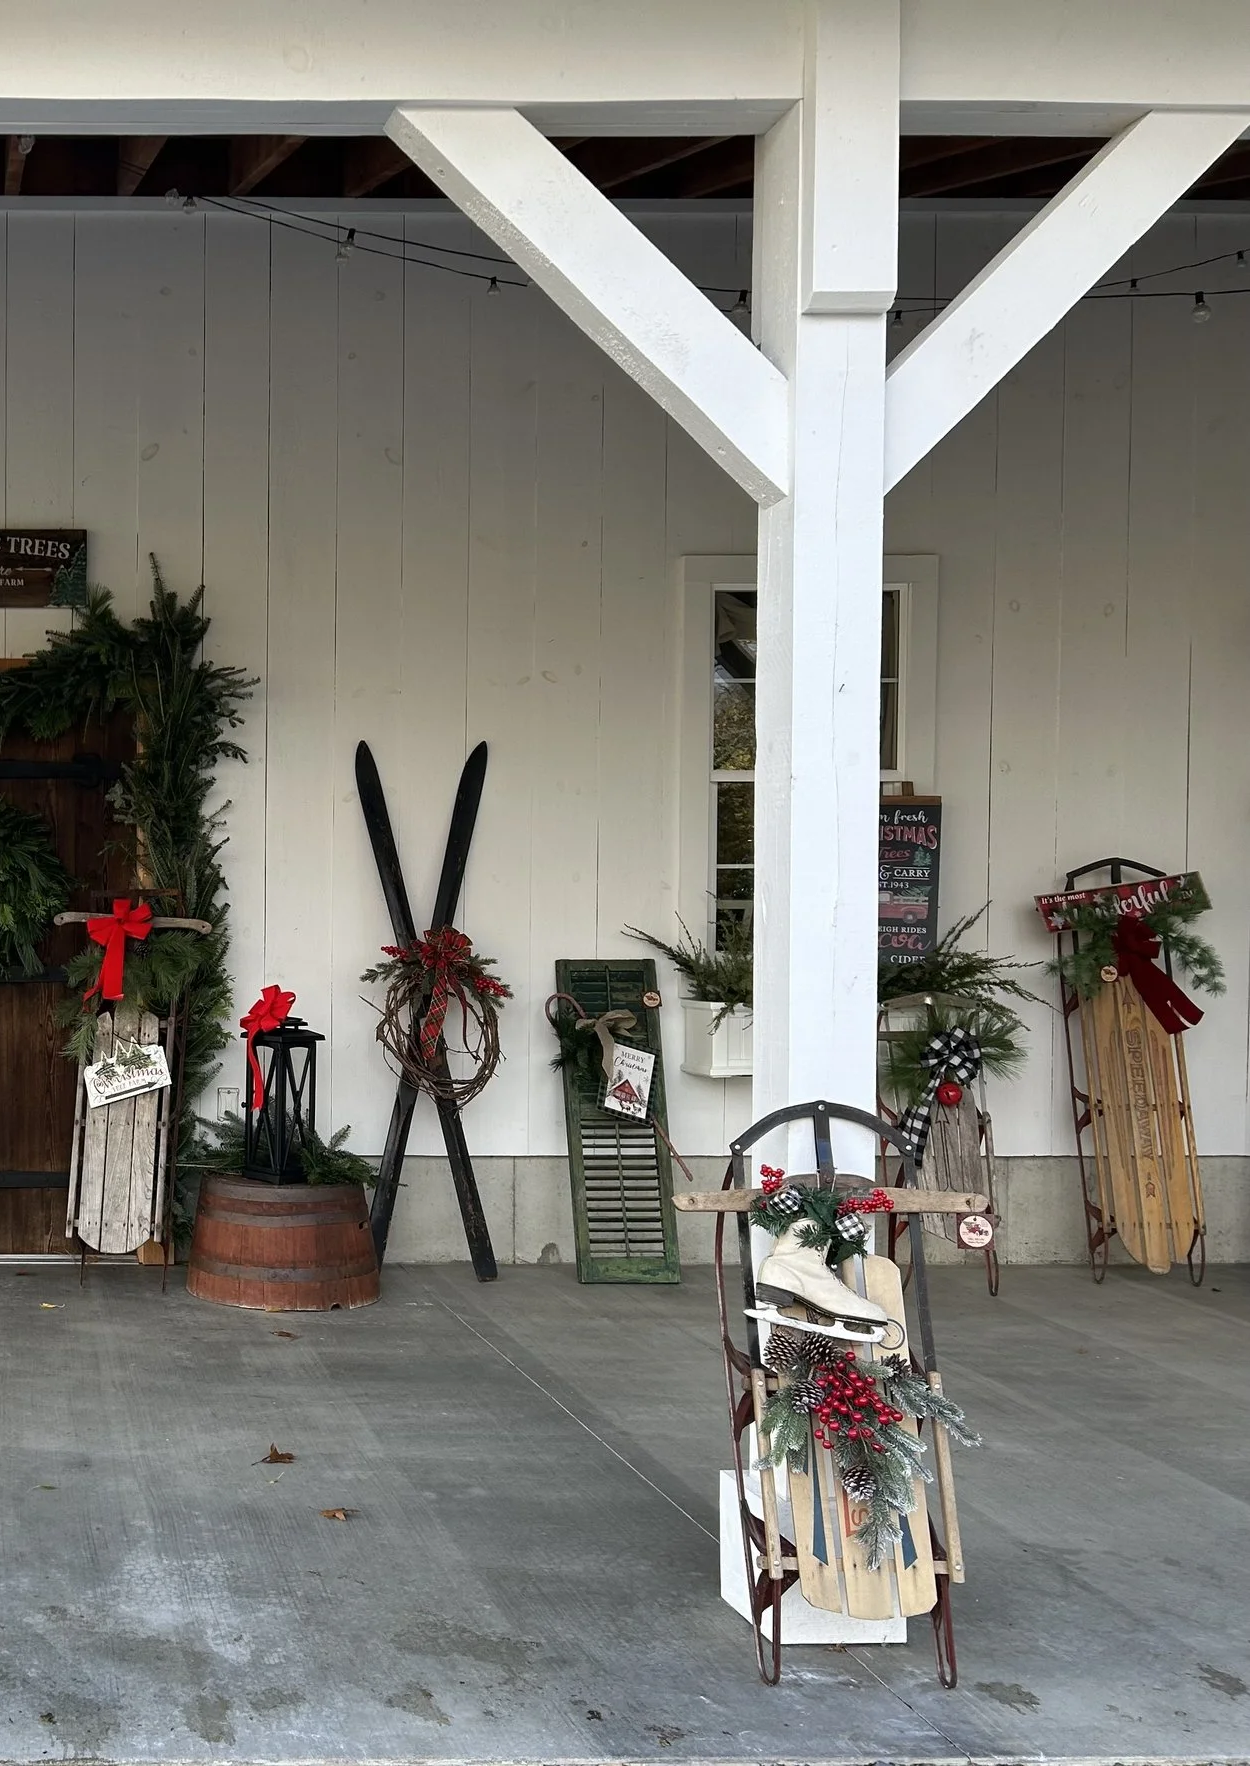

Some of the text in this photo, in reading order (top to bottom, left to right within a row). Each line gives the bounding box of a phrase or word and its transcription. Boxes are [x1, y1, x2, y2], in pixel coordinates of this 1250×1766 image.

[7, 536, 71, 559] TREES
[0, 578, 24, 587] FARM
[894, 809, 929, 825] fresh
[894, 868, 931, 878] CARRY
[1041, 892, 1086, 905] It's the most
[901, 926, 927, 934] RIDES
[622, 1051, 646, 1064] MERRY
[1126, 1029, 1154, 1161] SPEEDAWAY
